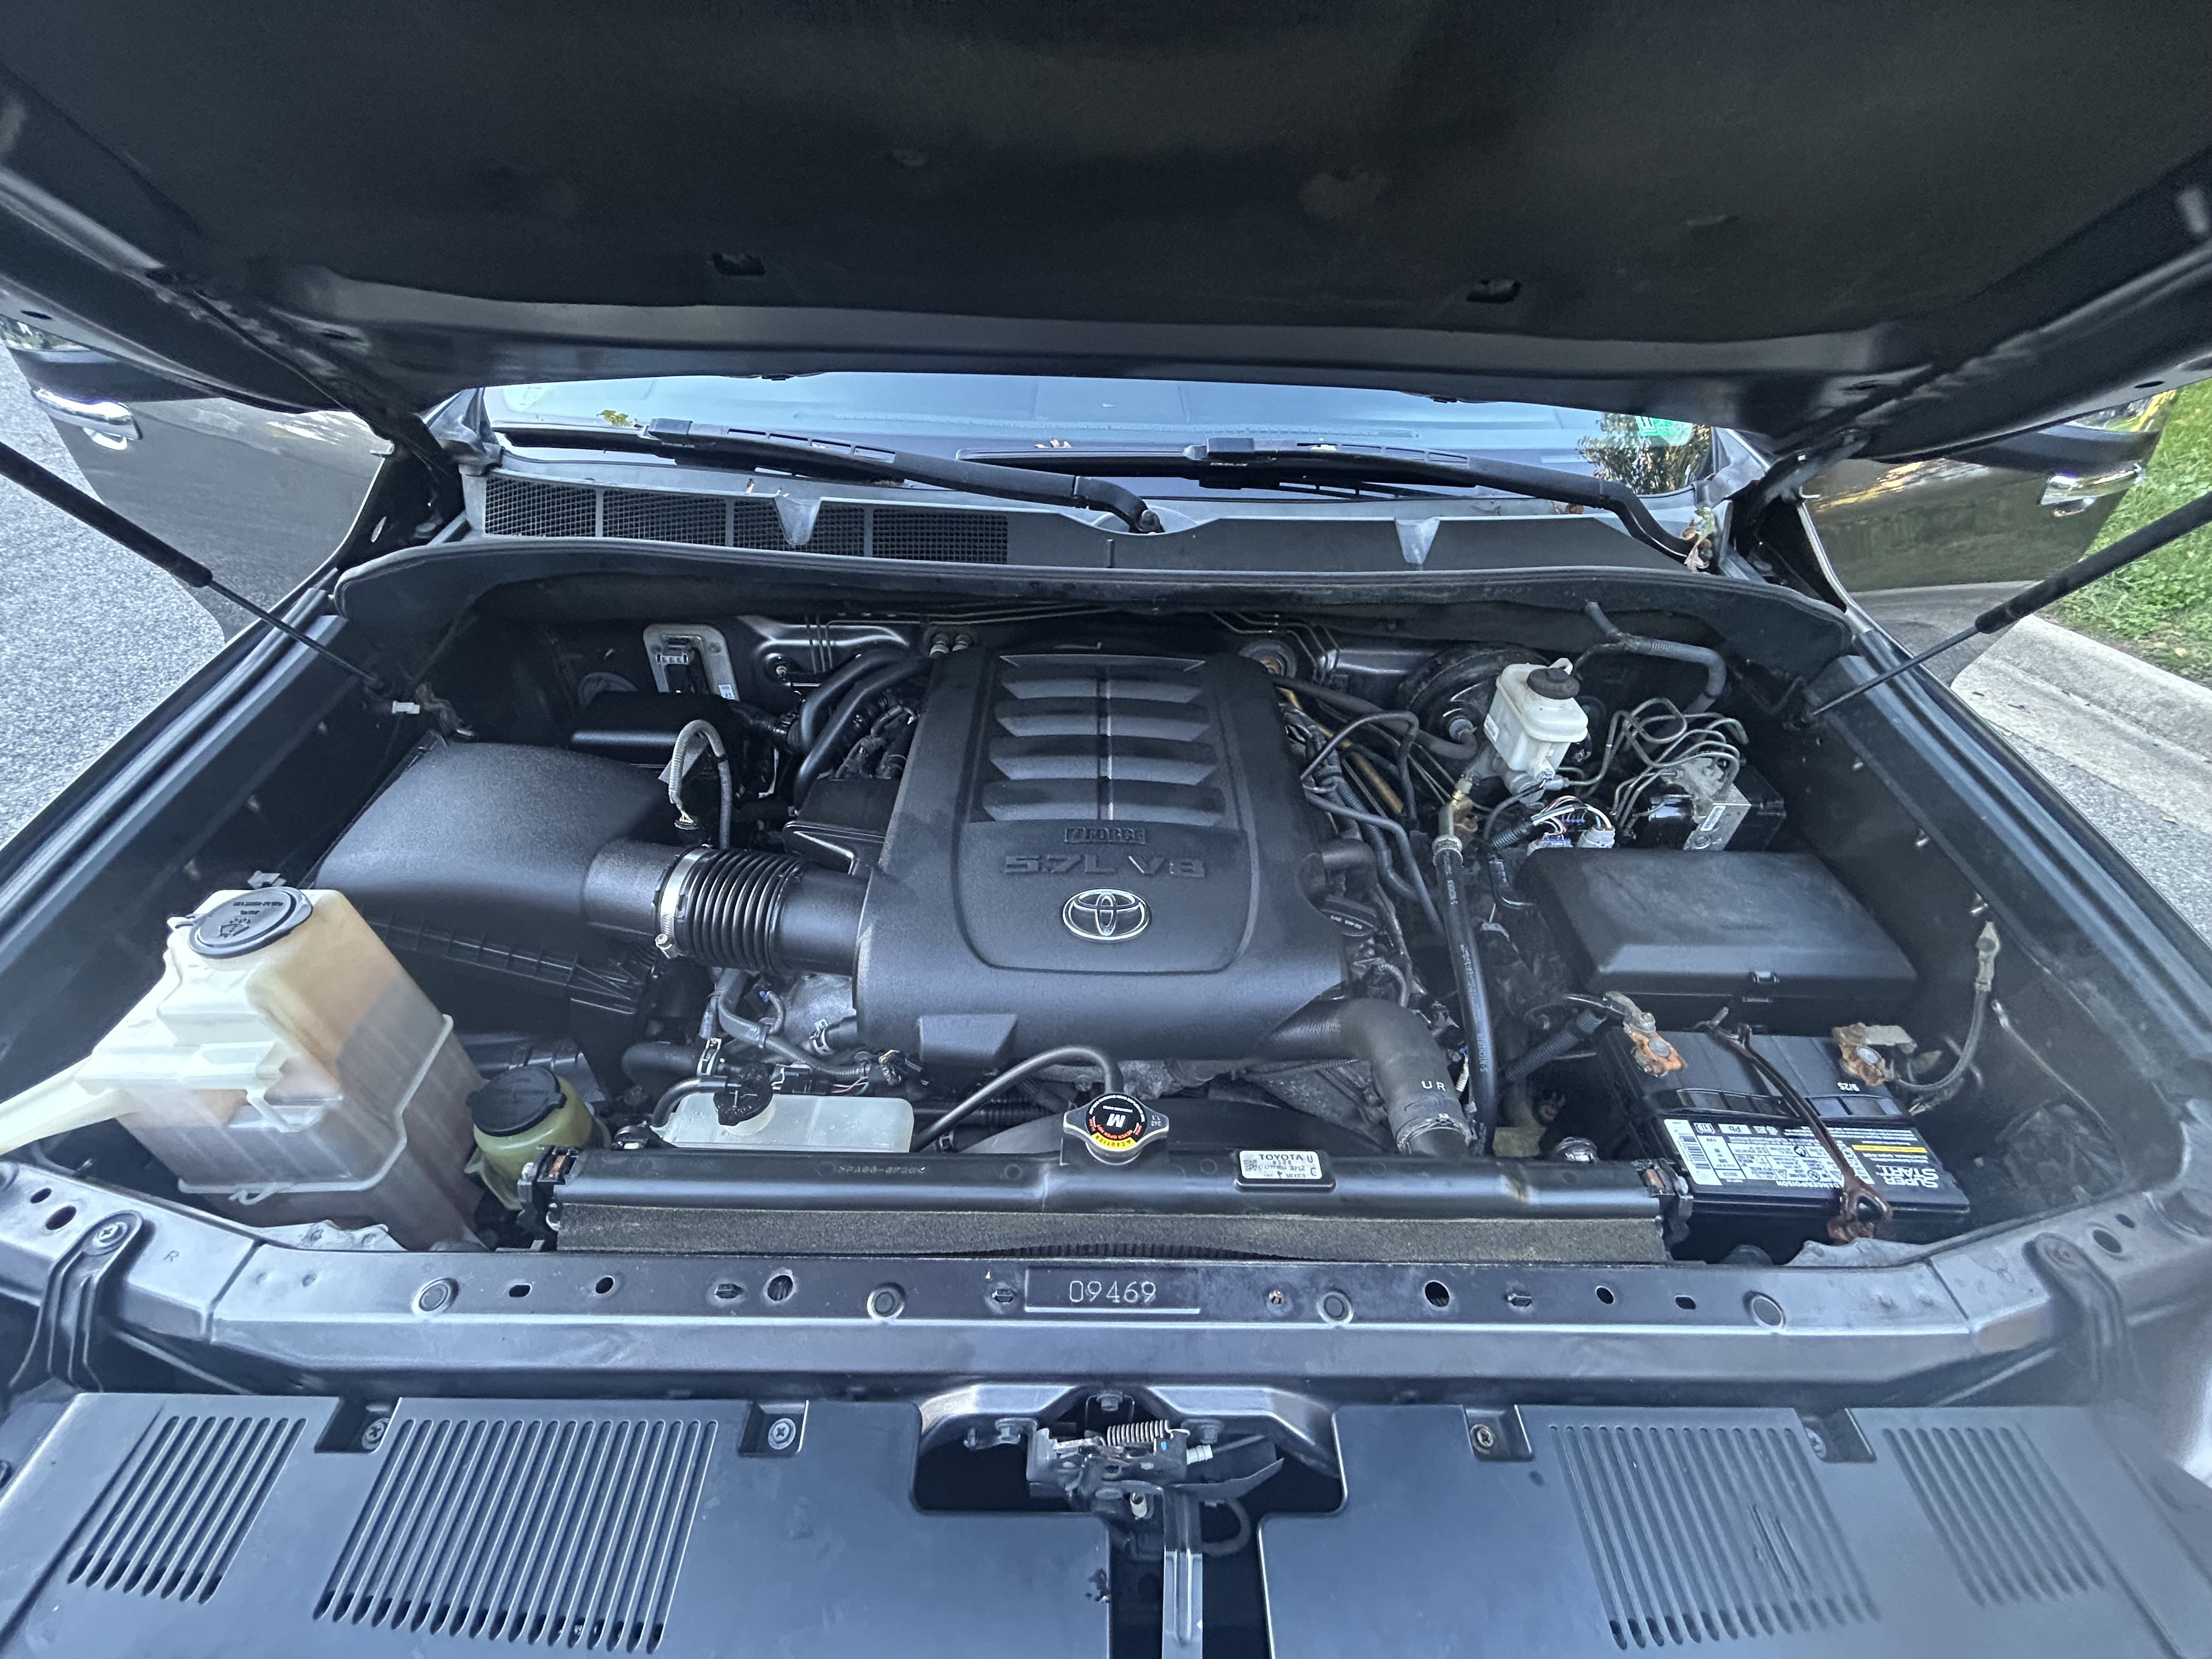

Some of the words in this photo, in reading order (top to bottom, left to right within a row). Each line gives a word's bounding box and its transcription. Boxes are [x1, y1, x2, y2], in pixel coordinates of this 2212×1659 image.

[1128, 855, 1206, 878] V8
[1094, 1135, 1126, 1147] CAUTION
[1306, 1154, 1313, 1163] U
[1310, 1167, 1317, 1176] C
[1878, 1167, 1939, 1181] START
[1775, 1180, 1840, 1189] DANGER/POISON
[1882, 1176, 1939, 1189] SUPER
[1069, 1280, 1157, 1304] 09469
